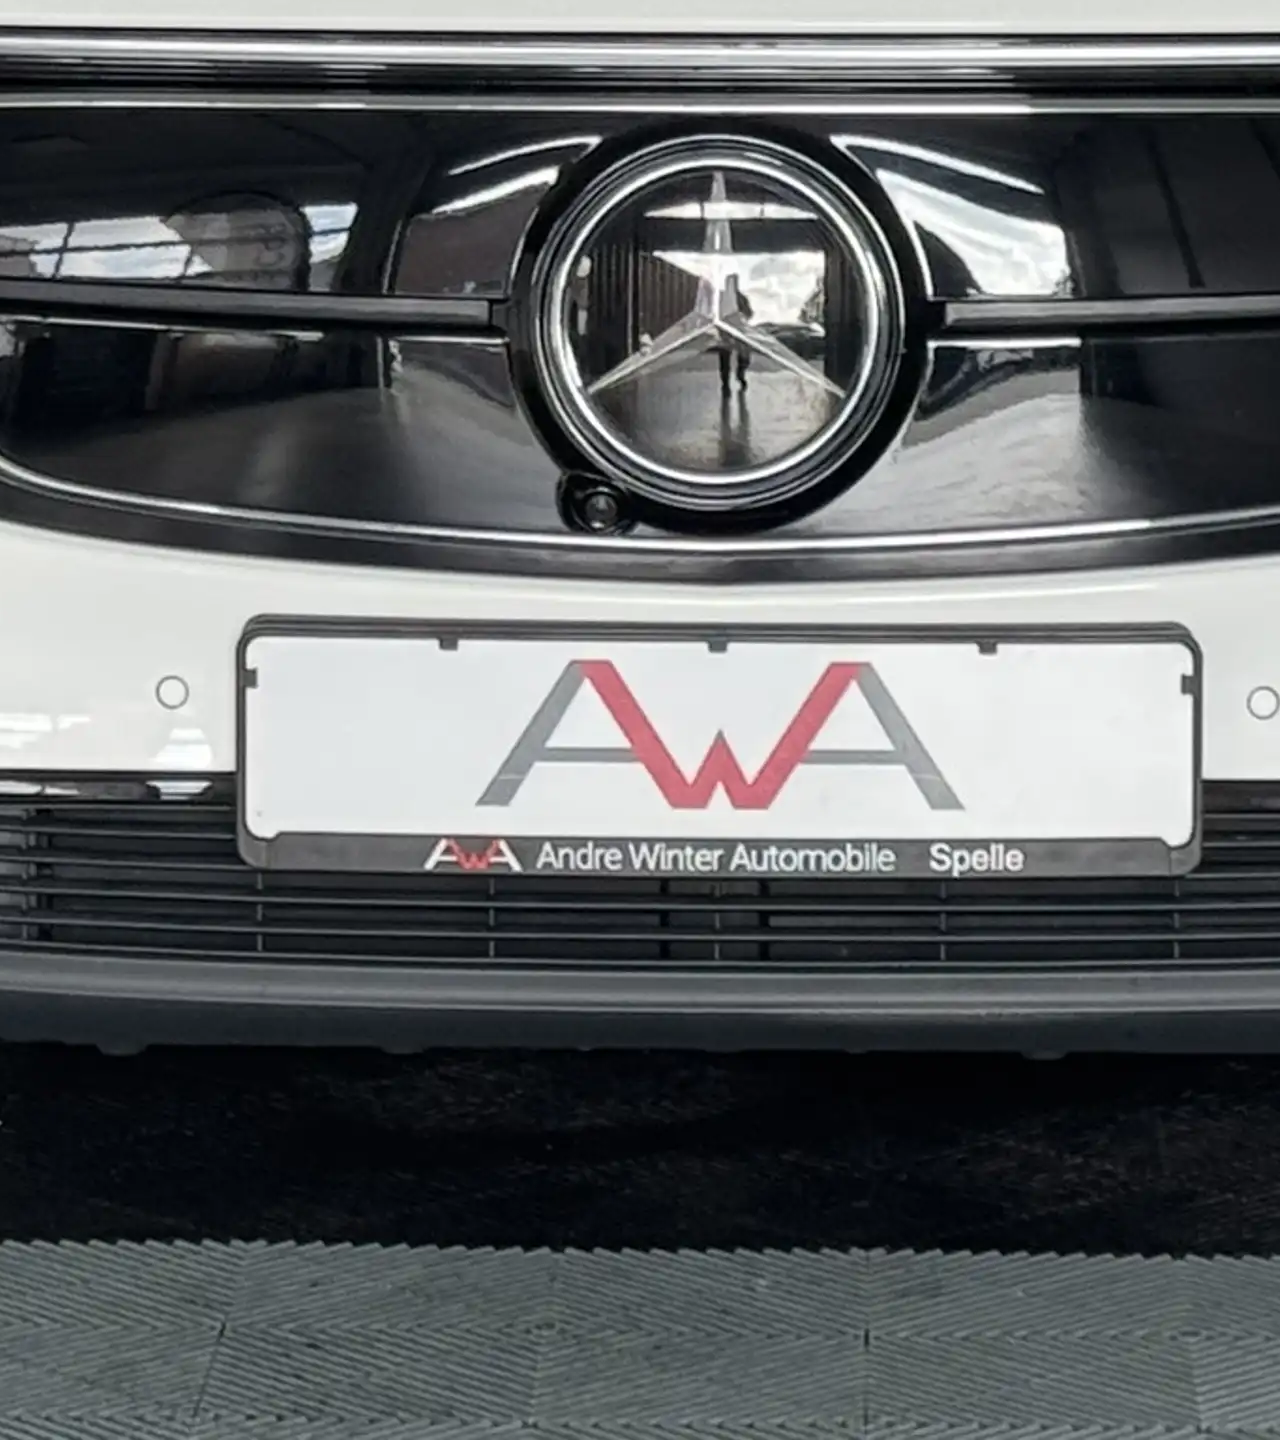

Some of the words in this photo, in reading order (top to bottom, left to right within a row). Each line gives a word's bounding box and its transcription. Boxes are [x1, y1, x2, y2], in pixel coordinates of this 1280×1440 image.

[475, 659, 966, 810] AWA
[536, 842, 622, 871] Andre
[628, 843, 723, 872] Winter
[729, 844, 896, 873] Automobile
[929, 843, 1024, 877] Spelle
